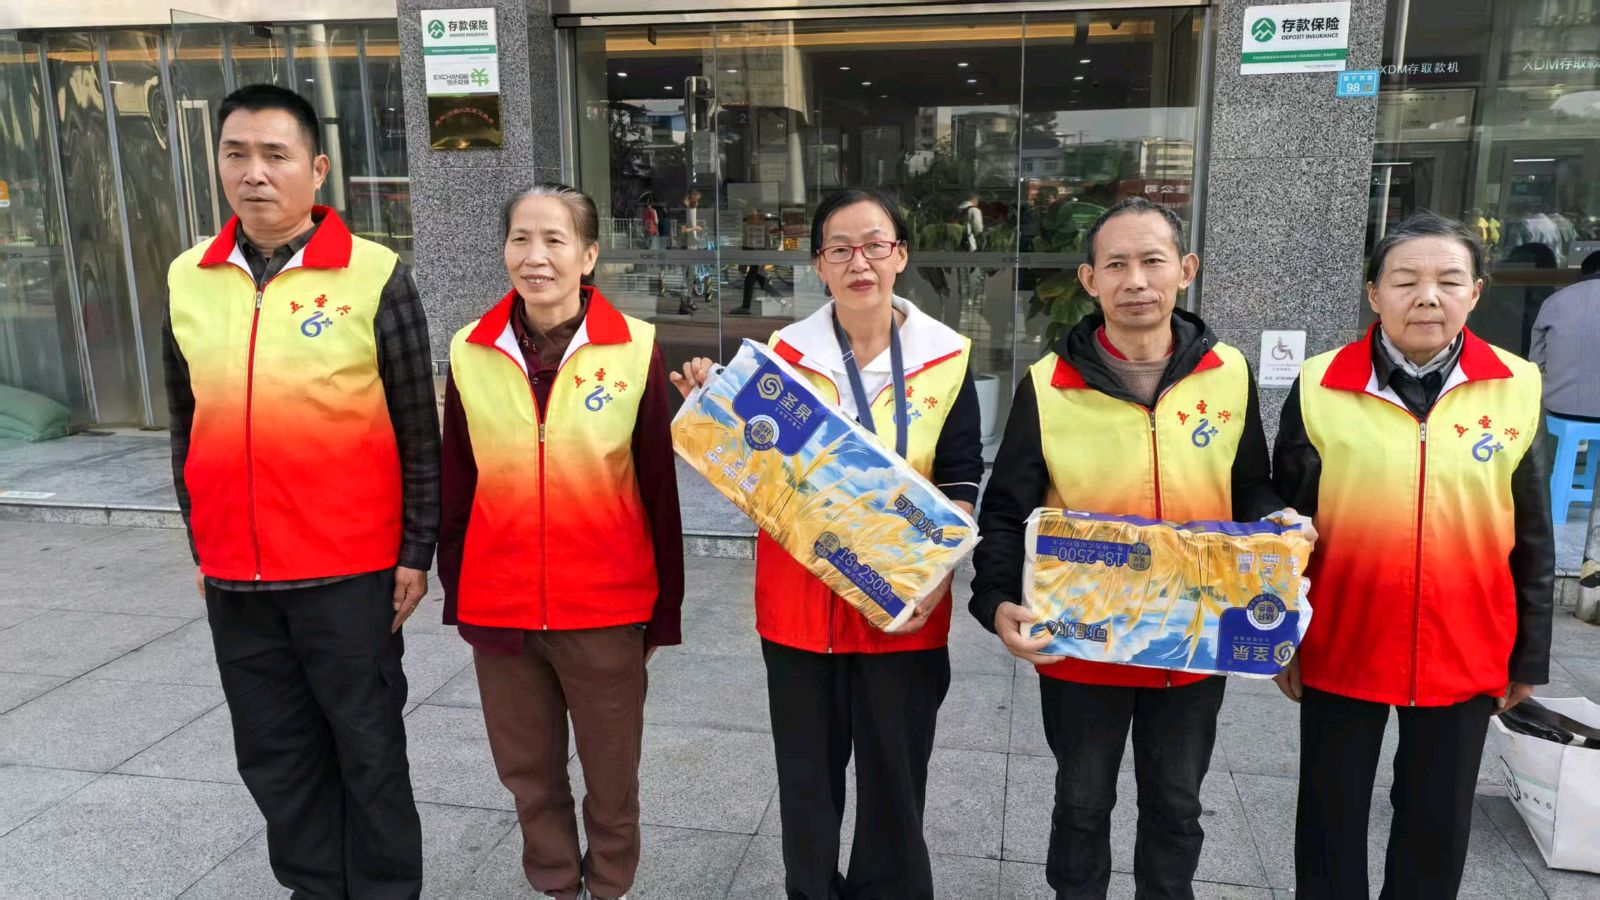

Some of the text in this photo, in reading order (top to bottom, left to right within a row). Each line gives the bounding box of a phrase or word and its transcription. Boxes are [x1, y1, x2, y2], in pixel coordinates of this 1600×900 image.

[448, 20, 488, 32] 存款保险
[1281, 17, 1340, 32] 存款保险
[1380, 62, 1459, 75] XDM存取款机
[433, 73, 470, 81] EXCHANGE
[1346, 82, 1360, 93] 98
[779, 392, 812, 423] 圣泉
[1233, 645, 1270, 662] 圣泉
